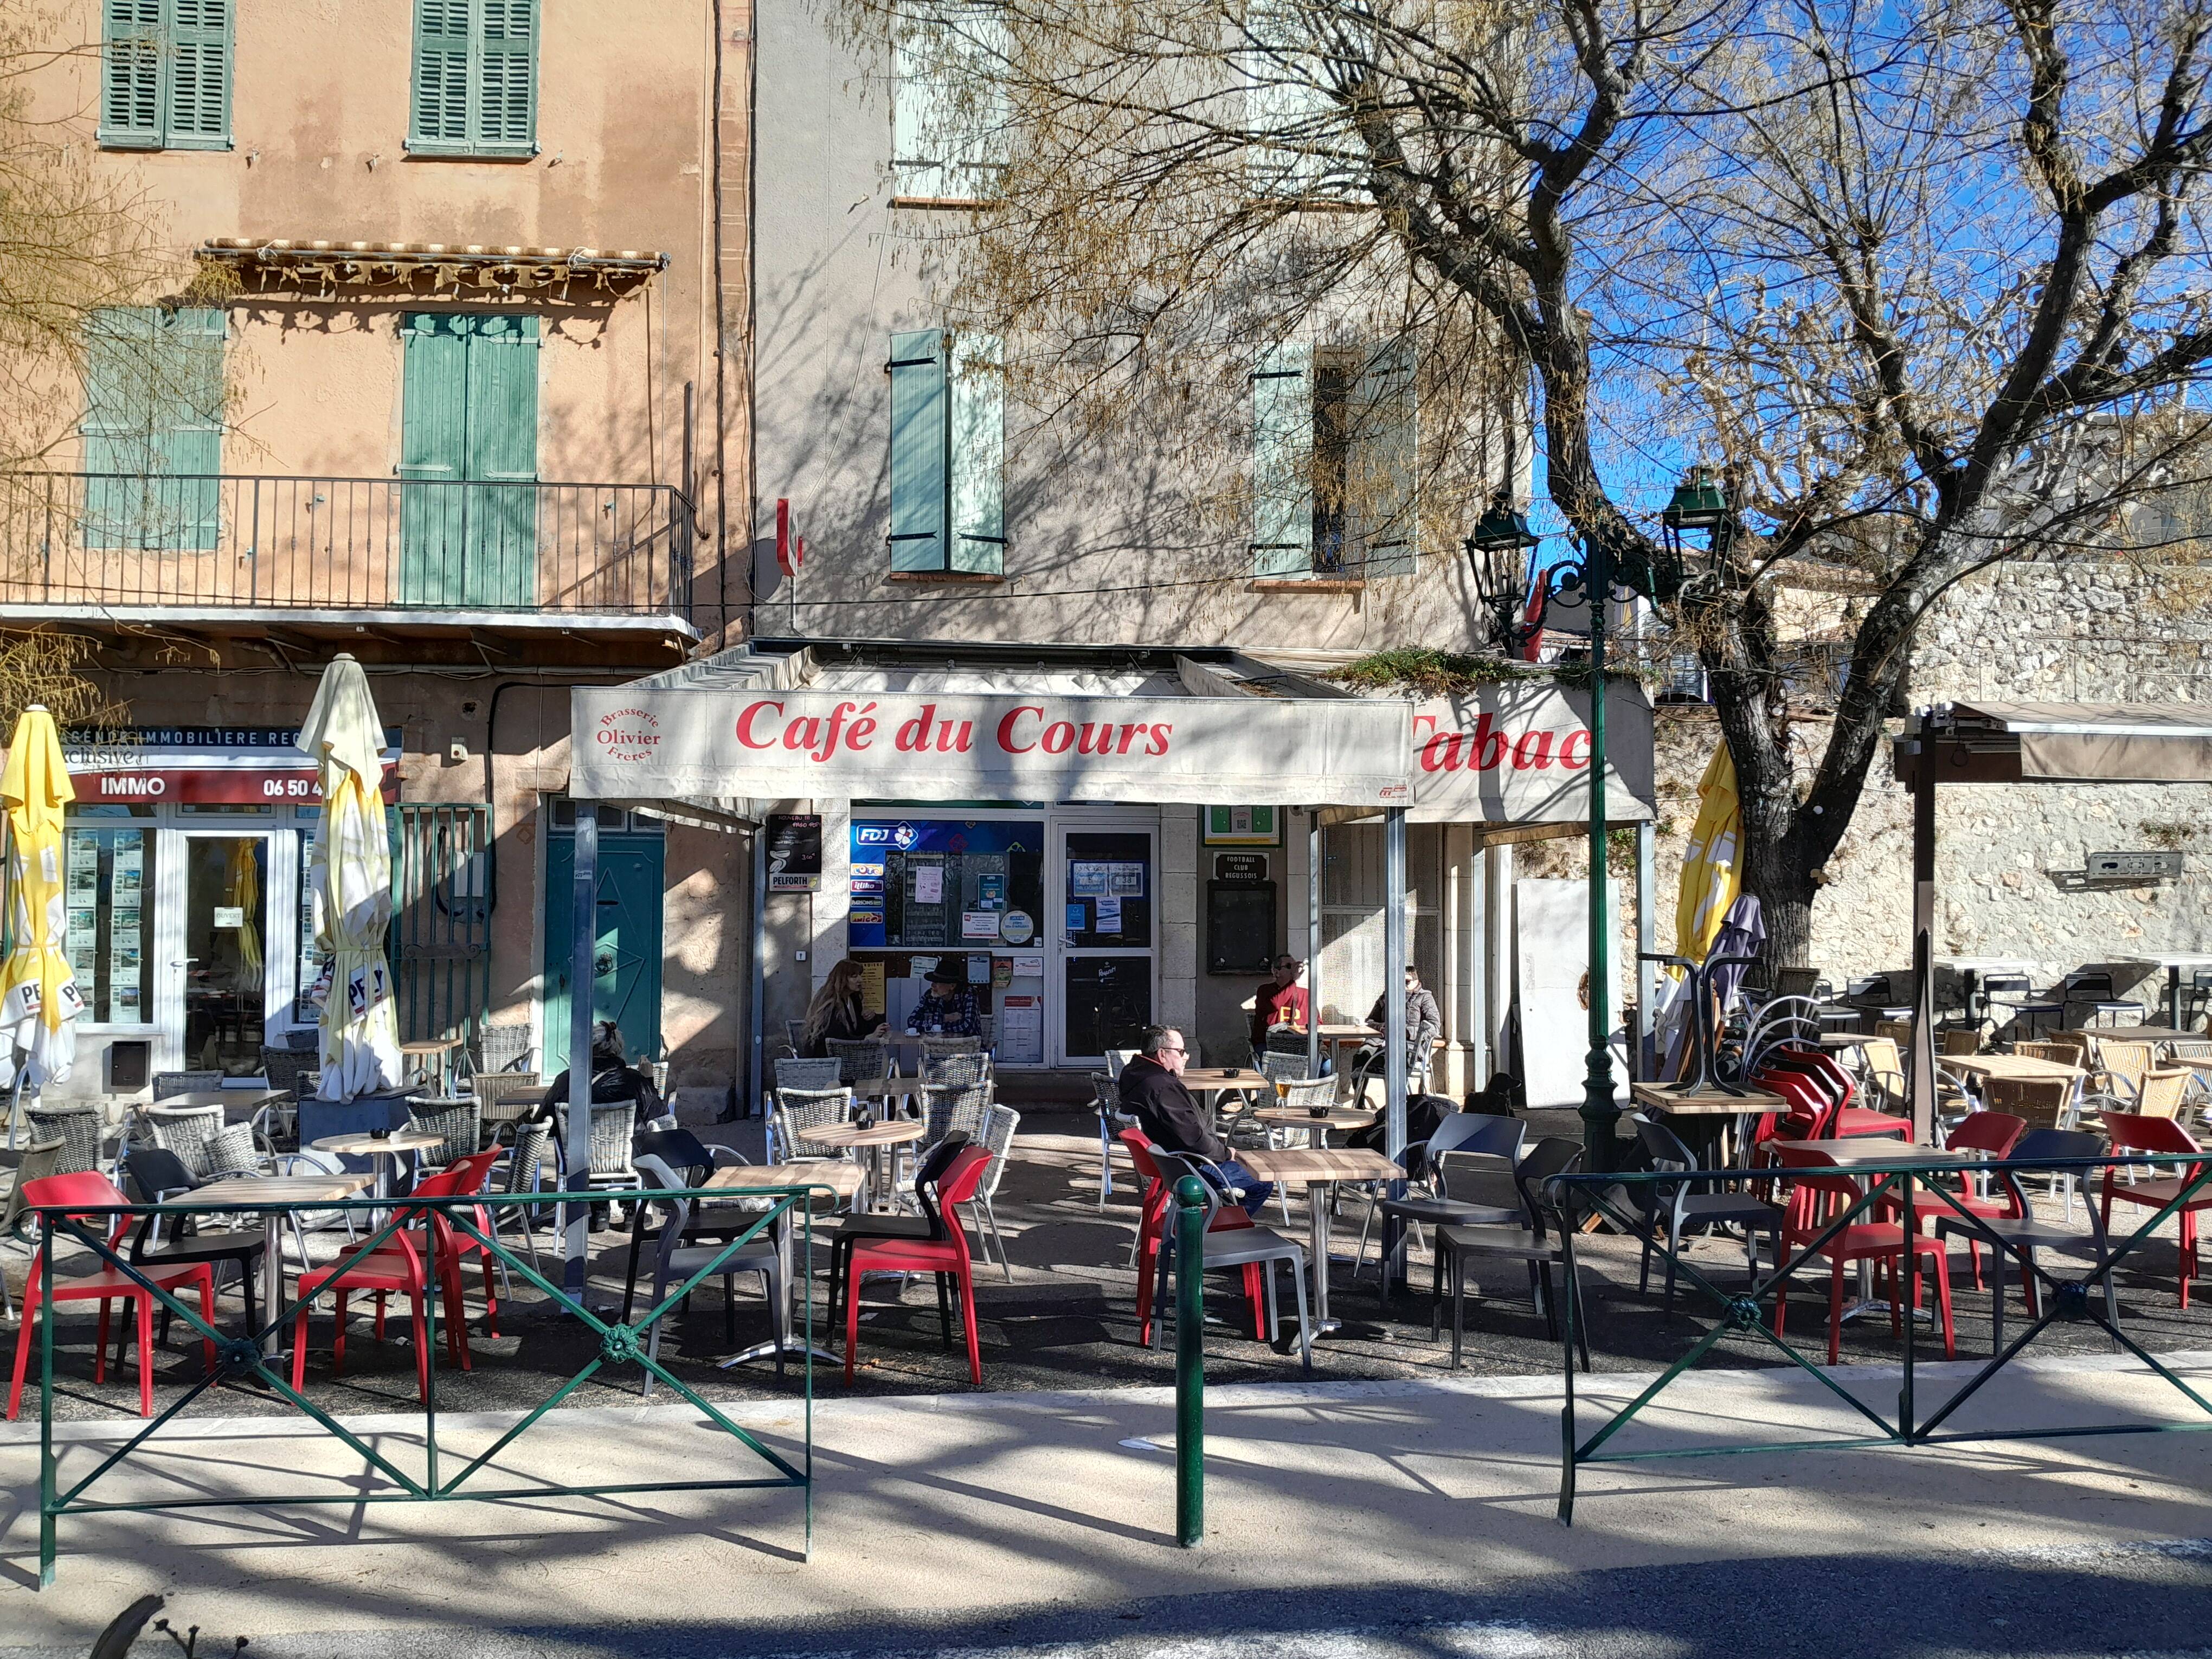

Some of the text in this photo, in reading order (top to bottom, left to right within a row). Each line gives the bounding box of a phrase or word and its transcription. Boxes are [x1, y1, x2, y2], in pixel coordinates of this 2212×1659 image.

[599, 708, 658, 727] Brasserie
[60, 731, 127, 743] AGENCE
[139, 731, 258, 744] IMMOBILIERE
[597, 729, 660, 745] Olivier
[736, 700, 1173, 762] Café du Cours
[606, 746, 652, 761] Frères
[101, 777, 165, 795] IMMO
[263, 780, 284, 796] 06
[288, 780, 308, 796] 50
[860, 828, 889, 841] FDJ
